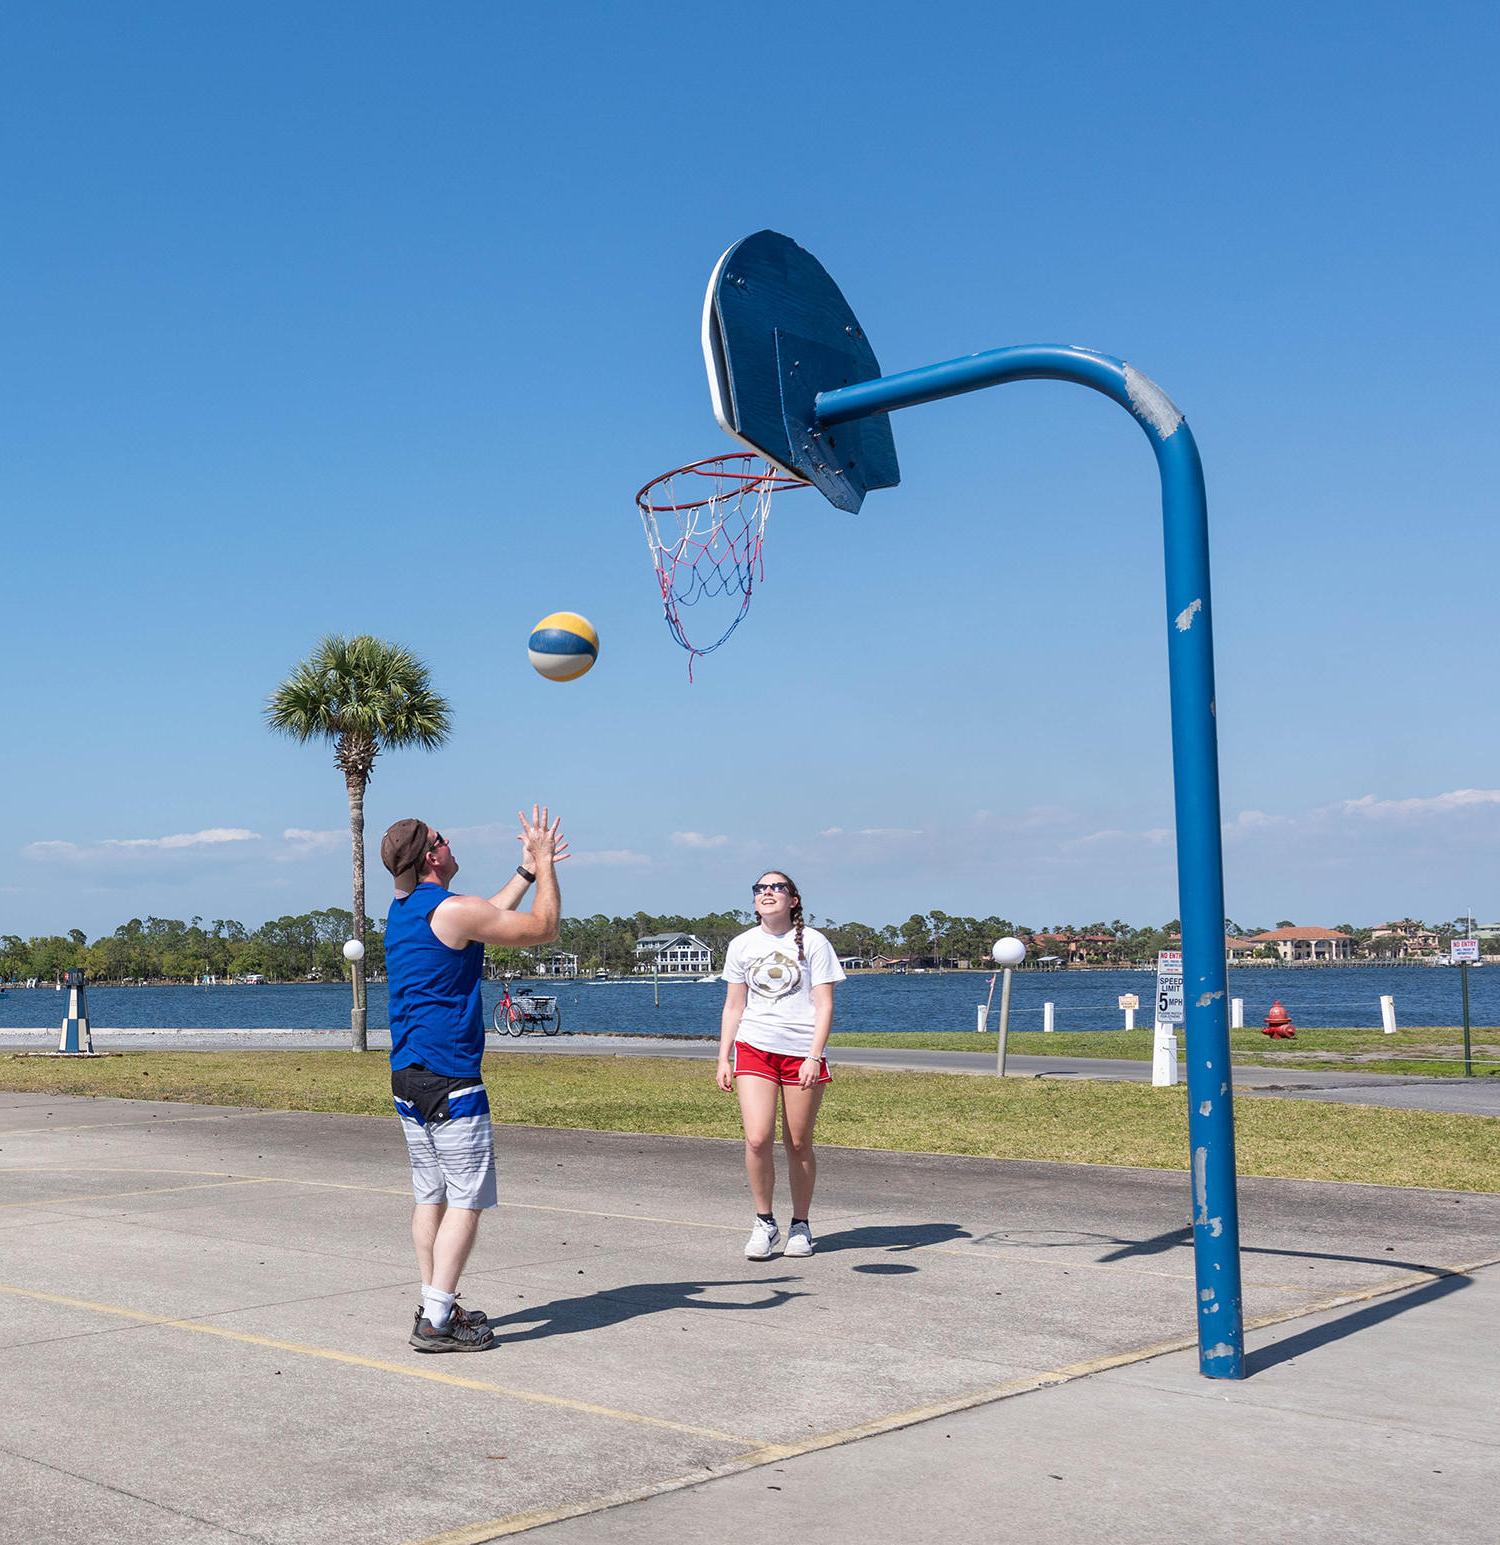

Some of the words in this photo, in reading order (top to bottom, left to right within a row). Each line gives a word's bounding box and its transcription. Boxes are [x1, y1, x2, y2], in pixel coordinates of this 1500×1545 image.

[1160, 977, 1183, 985] SPEED
[1159, 992, 1168, 1011] 5
[1169, 998, 1183, 1006] MPH
